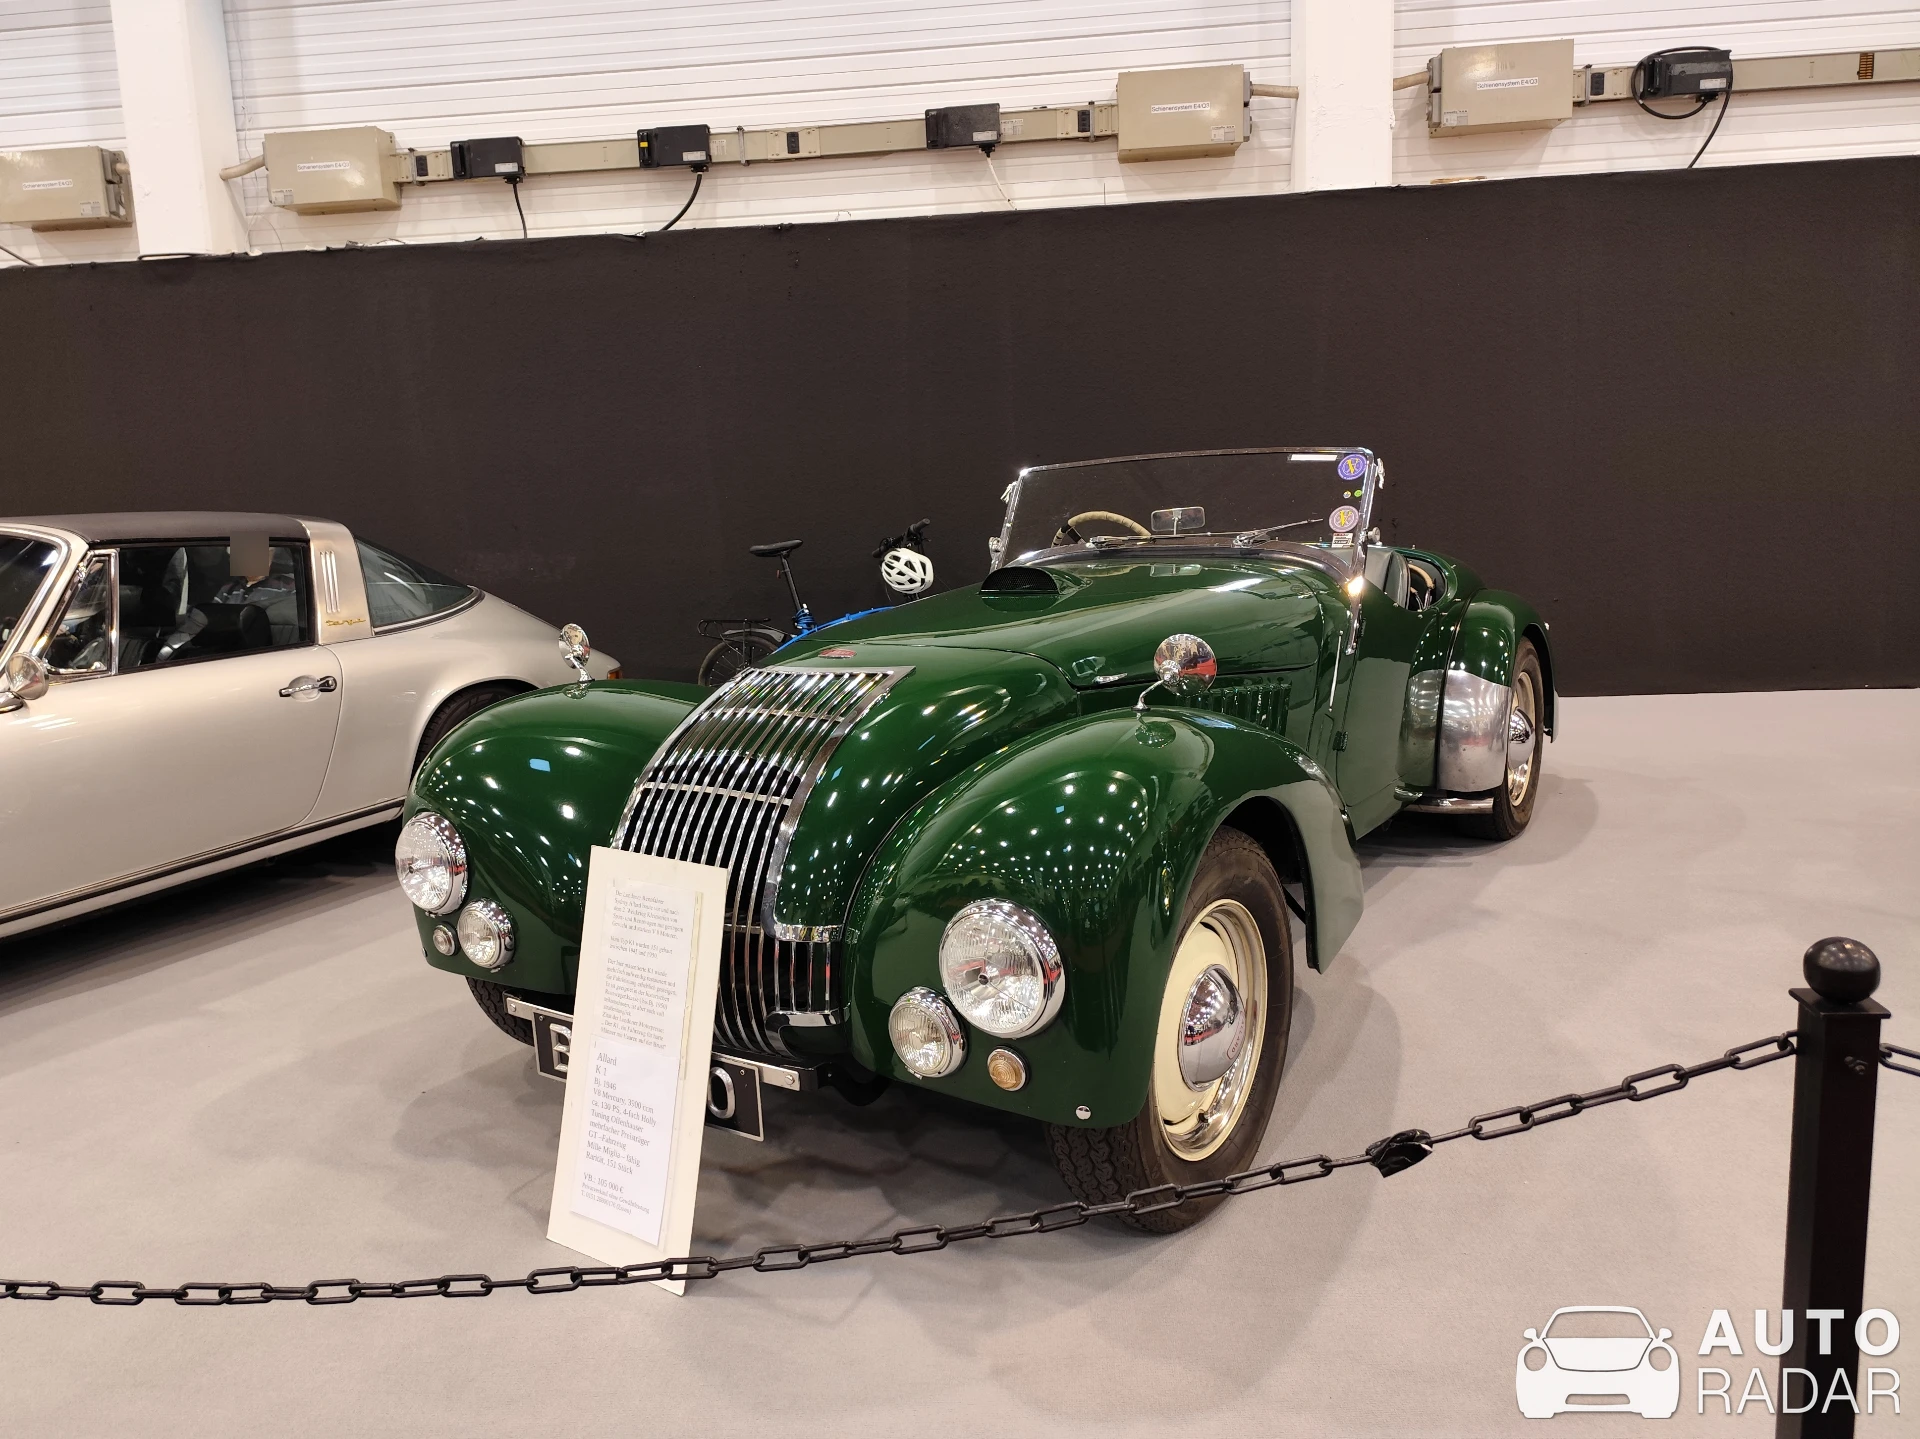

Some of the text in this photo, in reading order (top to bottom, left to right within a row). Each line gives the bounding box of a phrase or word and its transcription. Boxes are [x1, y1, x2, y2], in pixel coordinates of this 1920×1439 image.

[1477, 80, 1520, 88] Schienensystem
[597, 1052, 617, 1066] Allard
[596, 1065, 601, 1074] K
[604, 1081, 617, 1091] 1946
[593, 1088, 602, 1096] V8
[602, 1091, 627, 1106] Mercury,
[591, 1109, 644, 1132] Tuning Offenhauser
[623, 1108, 640, 1120] 4-fach
[641, 1115, 656, 1128] Holly
[589, 1130, 598, 1139] GT
[590, 1120, 650, 1148] mehrfacher Preisträger
[587, 1140, 601, 1151] Mille
[603, 1146, 621, 1160] Miglia
[626, 1154, 641, 1168] fähig
[607, 1159, 616, 1168] 151
[618, 1163, 633, 1174] Stück
[598, 1178, 608, 1188] 105
[608, 1182, 619, 1192] 000
